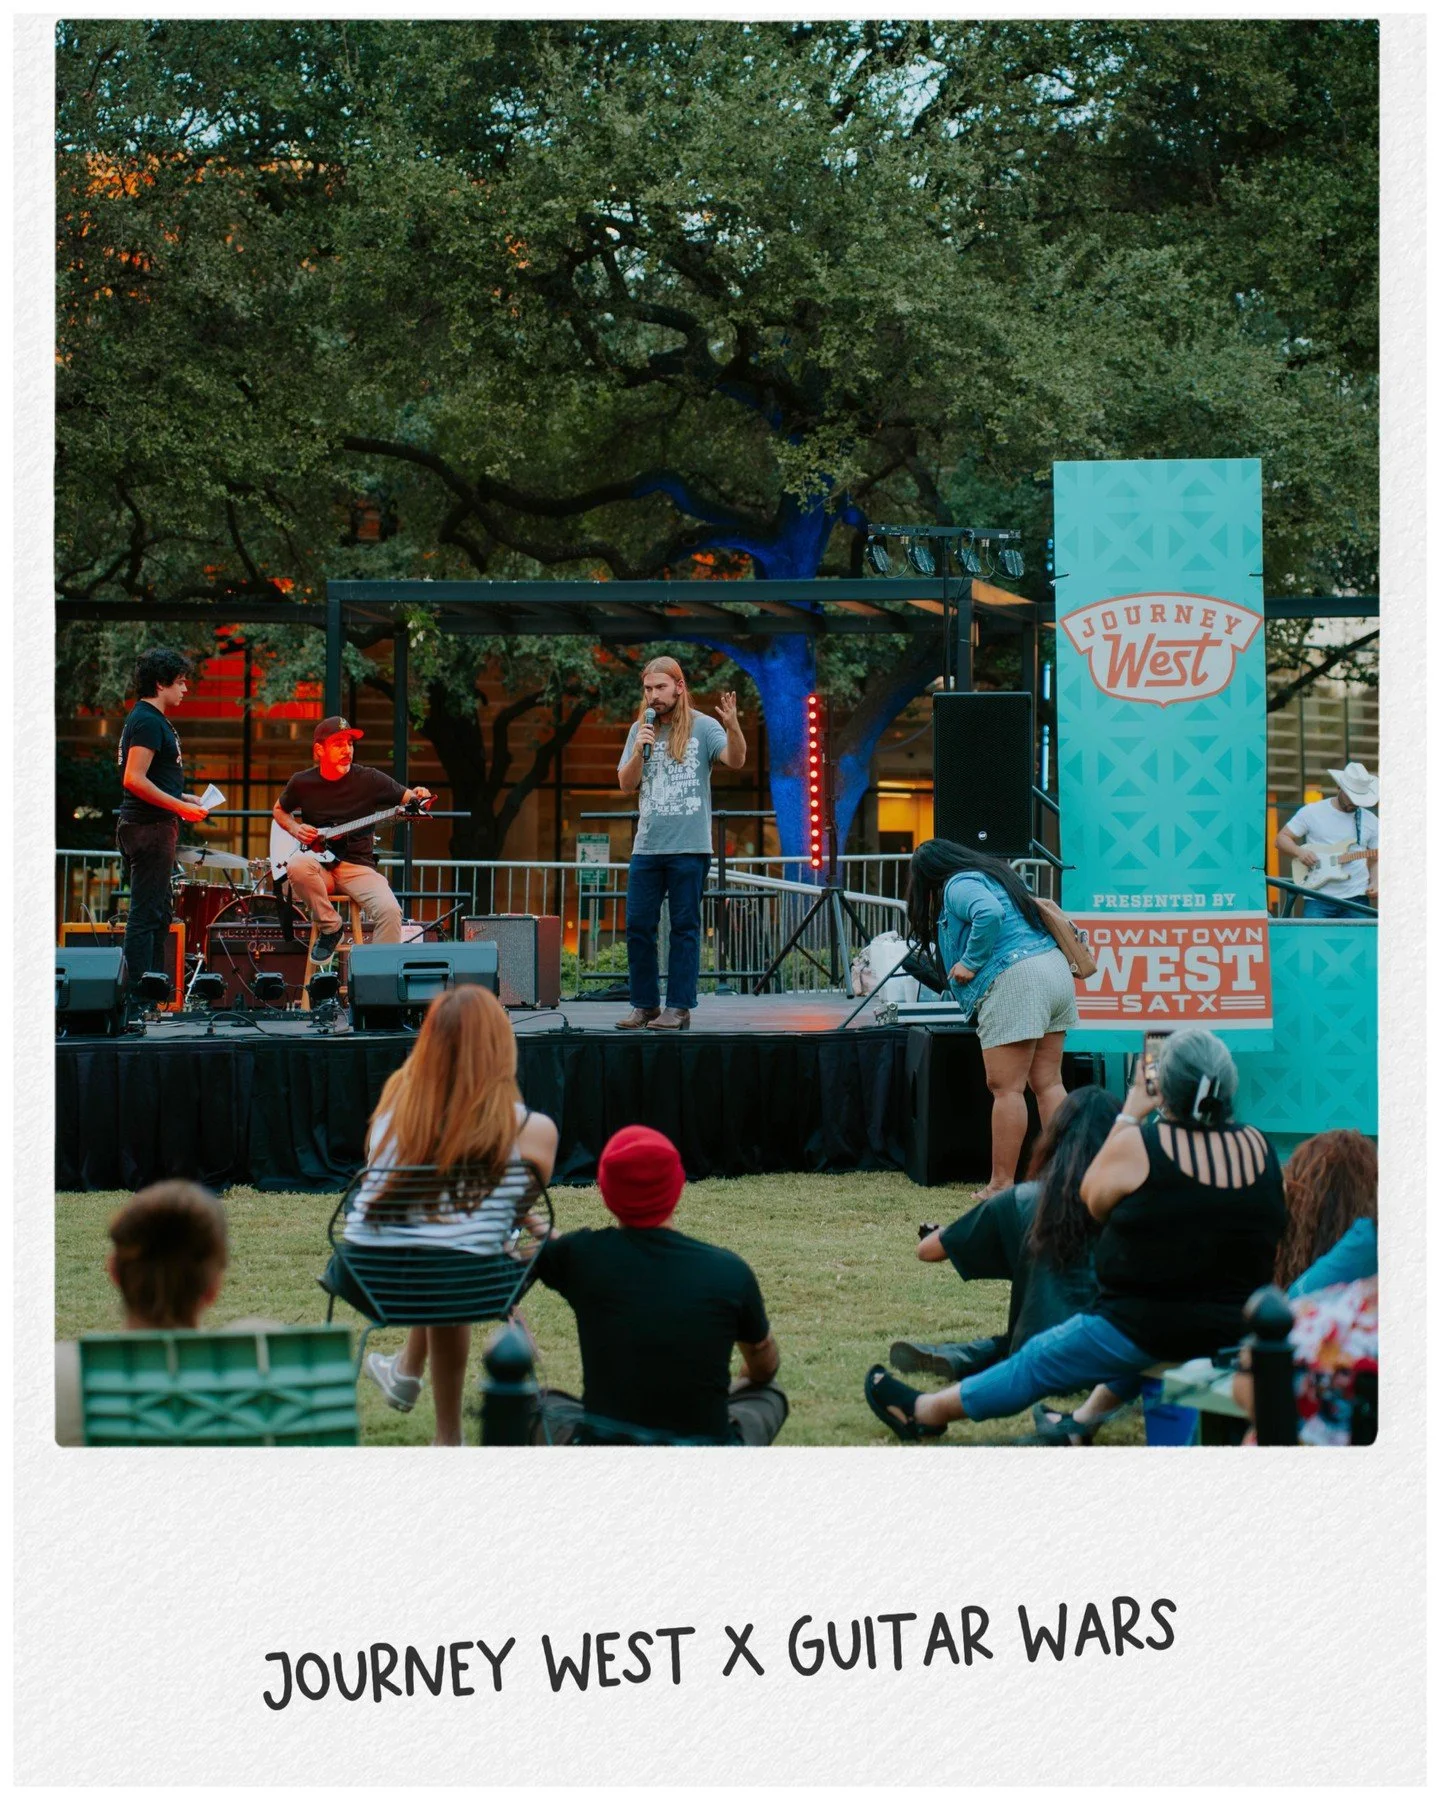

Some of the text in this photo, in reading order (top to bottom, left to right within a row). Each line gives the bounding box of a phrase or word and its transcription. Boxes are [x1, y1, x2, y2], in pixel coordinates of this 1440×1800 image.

[1082, 604, 1242, 638] JOURNEY
[1102, 632, 1223, 689] West
[1093, 893, 1236, 908] PRESENTED BY
[1083, 944, 1264, 992] WEST
[1121, 994, 1218, 1013] SATX
